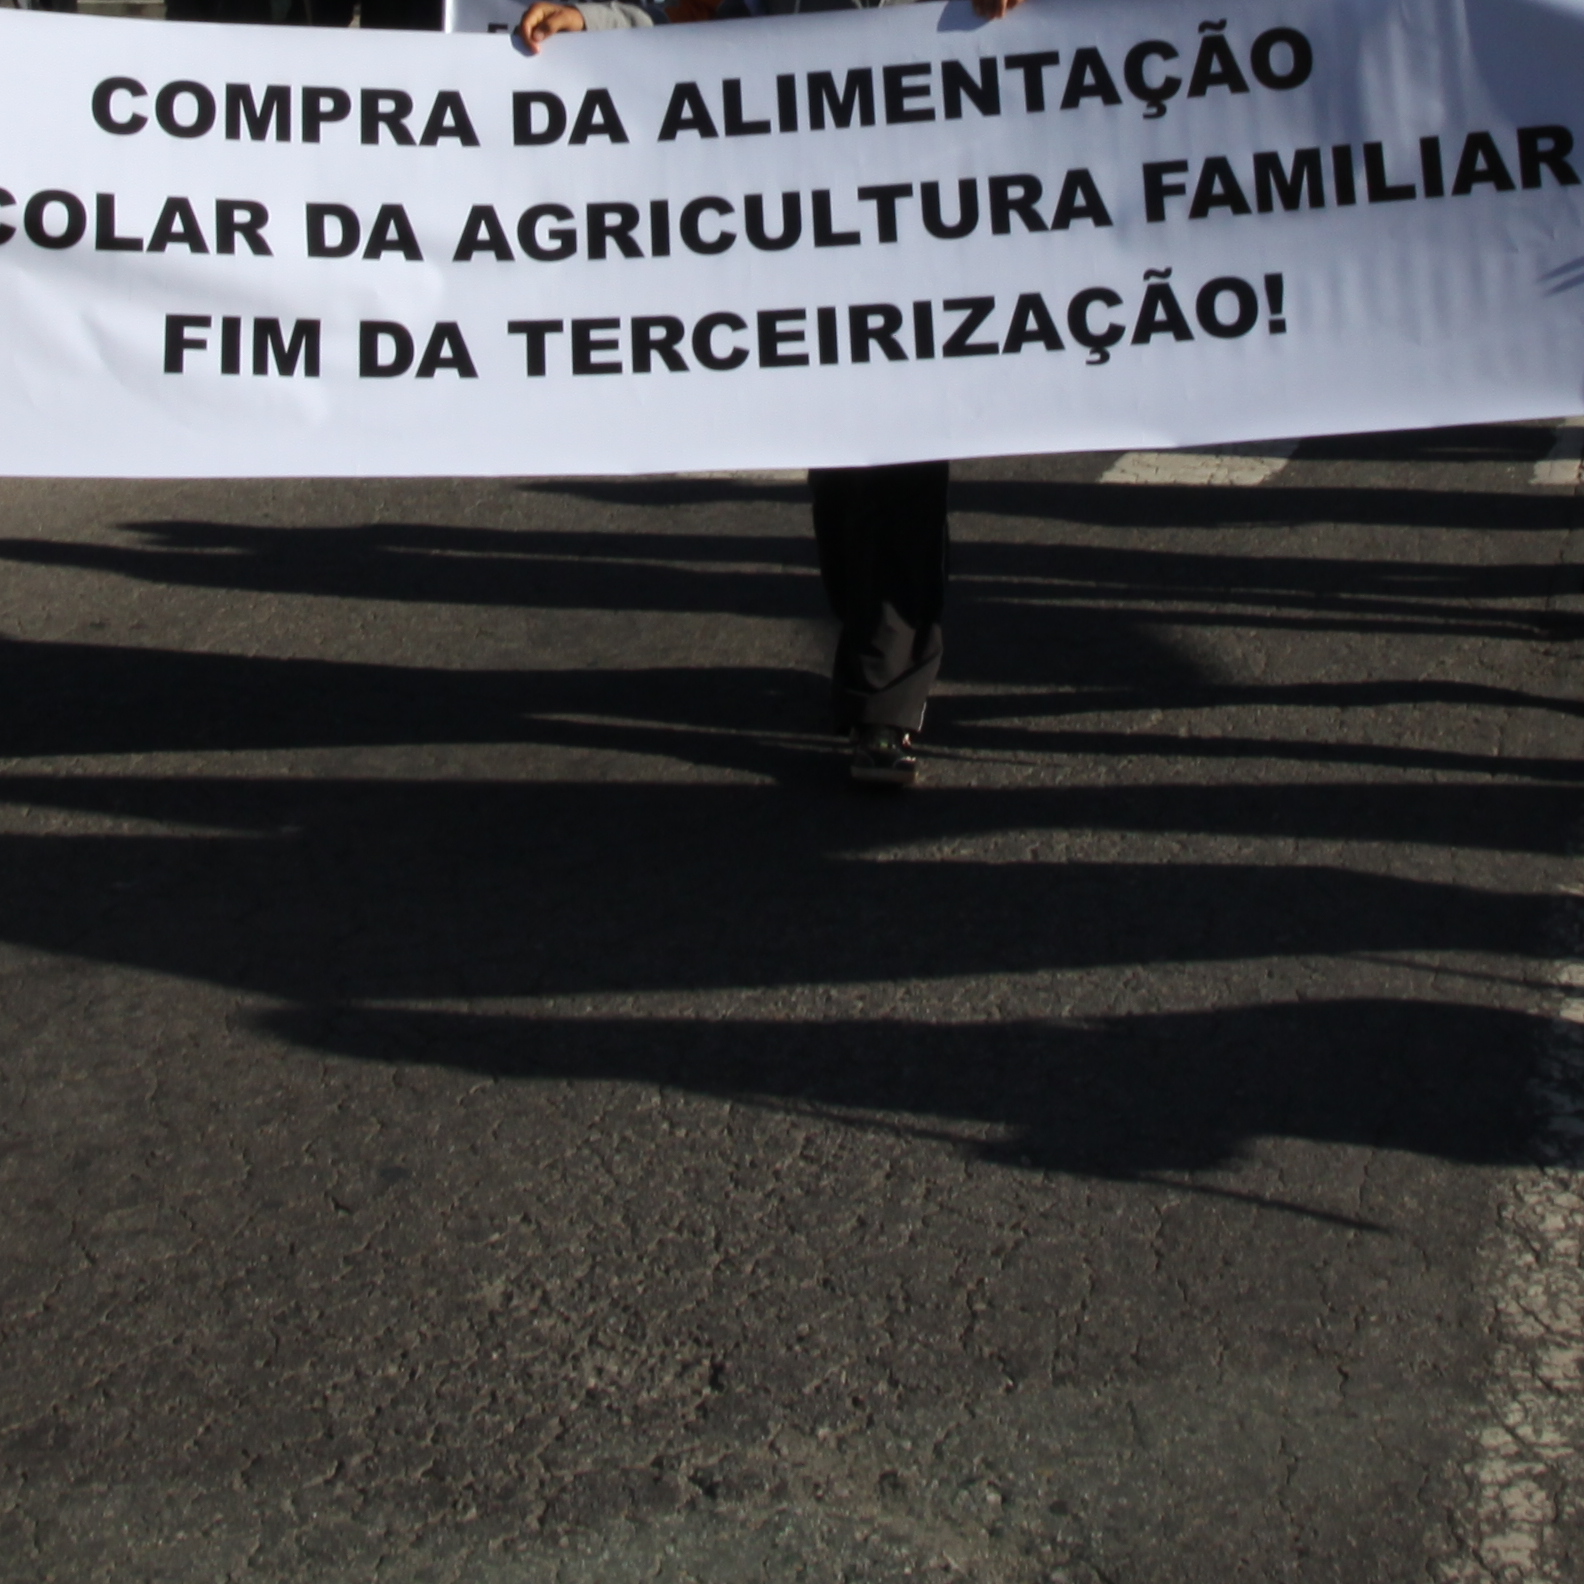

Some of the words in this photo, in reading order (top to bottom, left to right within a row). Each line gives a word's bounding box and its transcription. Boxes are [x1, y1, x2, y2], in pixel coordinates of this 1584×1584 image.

[92, 78, 479, 146] COMPRA
[513, 88, 628, 145] DA
[658, 17, 1316, 141] ALIMENTAÇÃO
[306, 204, 422, 260] DA
[453, 168, 1113, 261] AGRICULTURA
[1142, 126, 1582, 223] FAMILIAR
[164, 315, 321, 377] FIM
[359, 321, 477, 378] DA
[508, 267, 1287, 376] TERCEIRIZAÇÃO!
